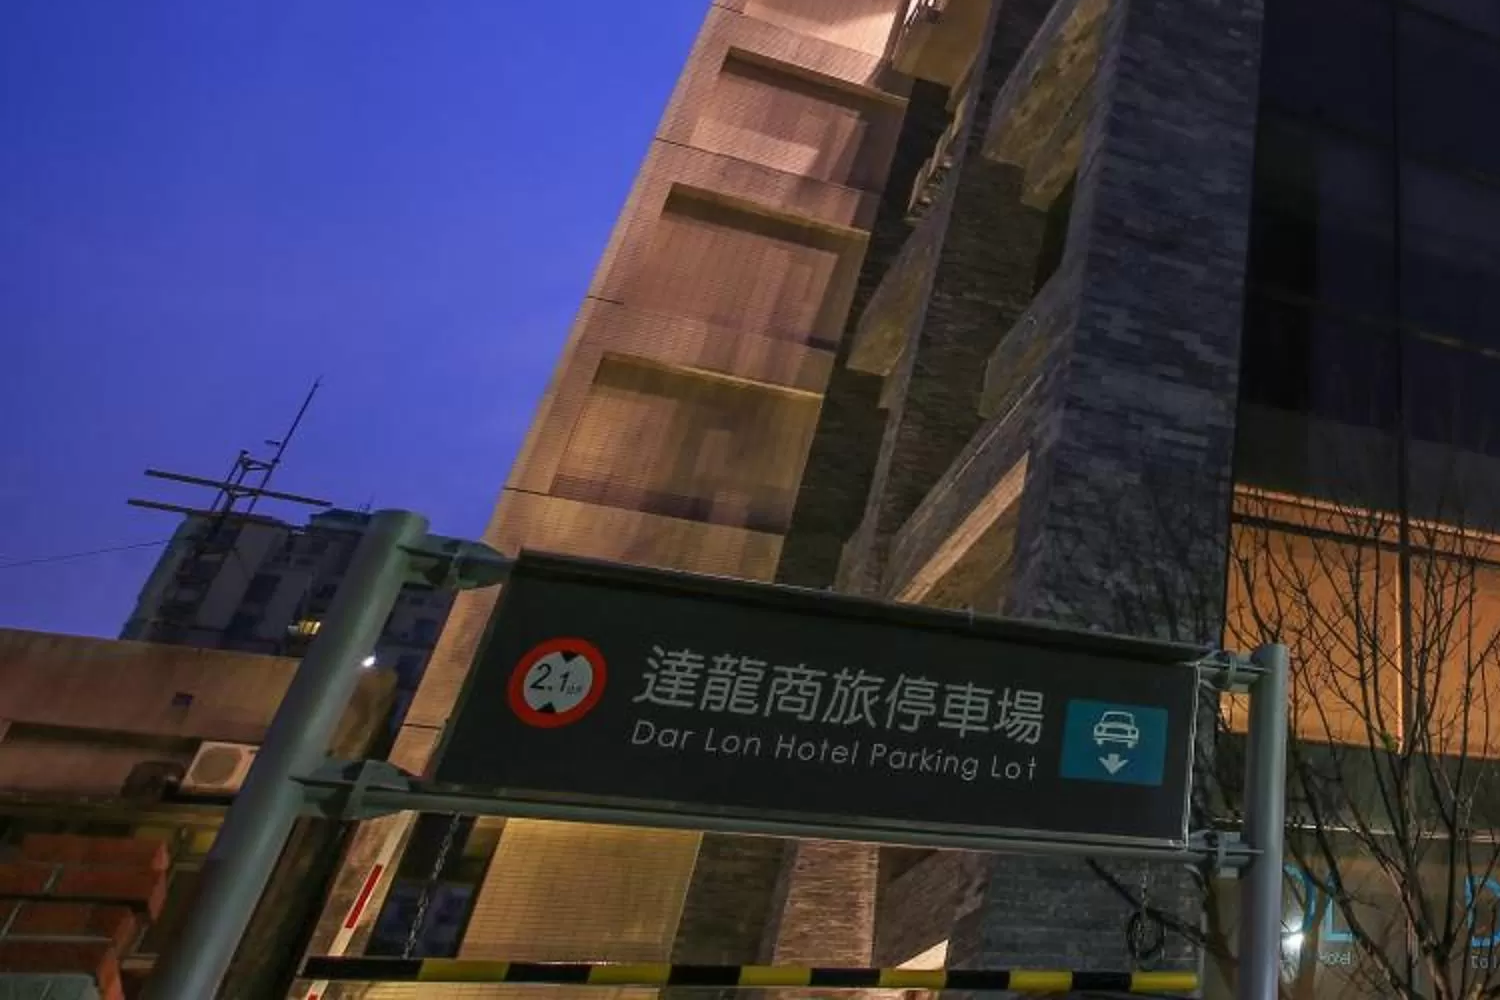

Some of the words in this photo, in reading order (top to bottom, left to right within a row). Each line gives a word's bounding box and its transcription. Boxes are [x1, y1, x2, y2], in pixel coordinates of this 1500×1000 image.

[631, 644, 1047, 746] 達龍商旅停車場
[631, 719, 695, 750] Dar
[704, 727, 762, 758] Lon
[774, 735, 859, 767] Hotel
[869, 743, 980, 782] Parking
[991, 755, 1038, 782] Lot
